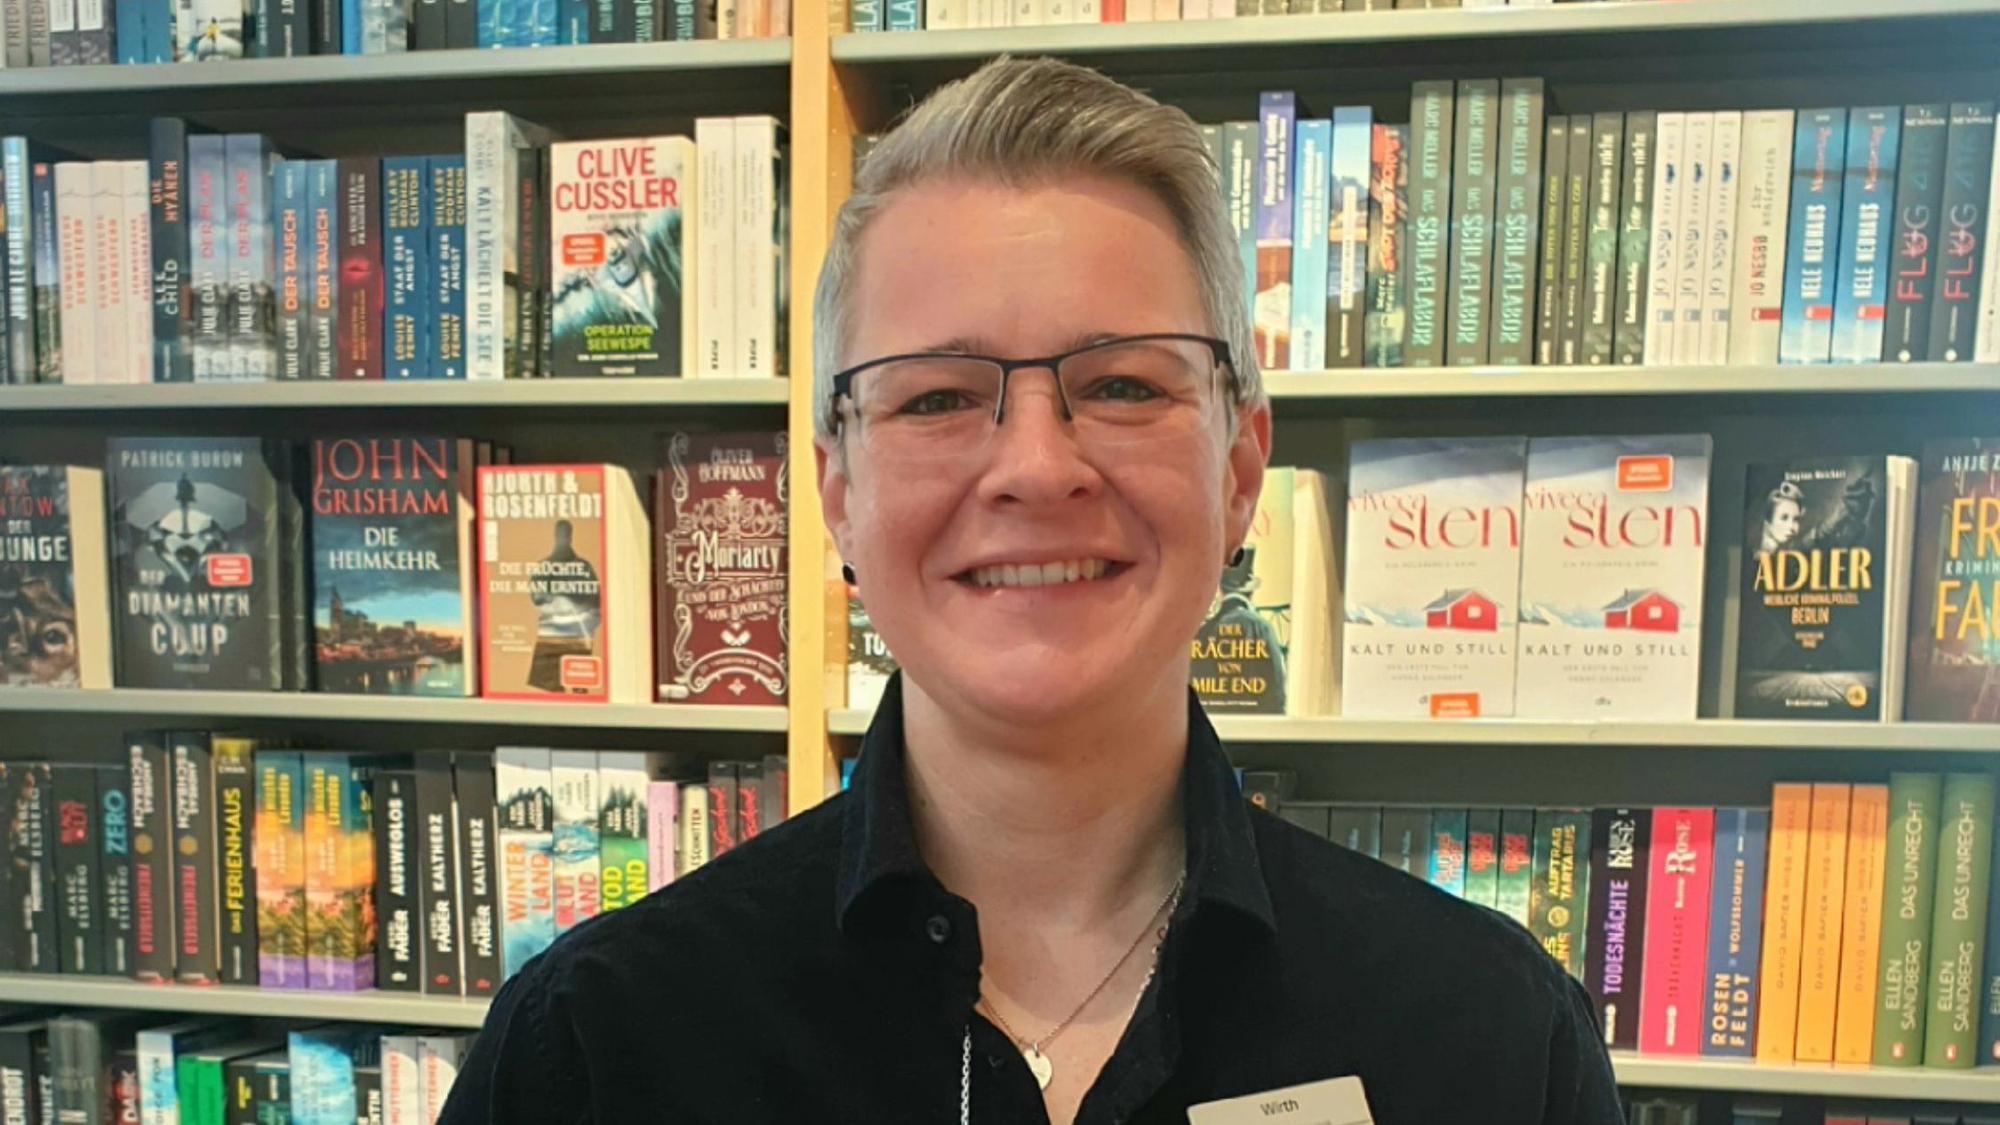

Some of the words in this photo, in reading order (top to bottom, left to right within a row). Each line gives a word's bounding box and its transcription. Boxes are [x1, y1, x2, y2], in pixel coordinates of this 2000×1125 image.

[577, 147, 655, 179] CLIVE
[1423, 129, 1439, 179] MELLER
[1467, 127, 1484, 176] MELLER
[1511, 126, 1527, 175] MELLER
[153, 179, 163, 203] DIE
[399, 168, 408, 227] RODHAM
[409, 168, 419, 227] CLINTON
[445, 167, 454, 225] RODHAM
[456, 167, 465, 224] CLINTON
[476, 187, 492, 223] KALT
[555, 177, 679, 212] CUSSLER
[1422, 190, 1436, 212] DAS
[1466, 188, 1481, 209] DAS
[1509, 187, 1525, 209] DAS
[285, 209, 297, 271] TAUSCH
[317, 208, 329, 270] TAUSCH
[394, 236, 404, 261] DER
[440, 234, 449, 260] DER
[1804, 204, 1827, 262] NEUHAUS
[1856, 203, 1880, 262] NEUHAUS
[1896, 205, 1930, 300] FLUG
[1944, 204, 1978, 300] FLUG
[405, 249, 414, 291] ANGST
[440, 265, 449, 302] STAAT
[450, 248, 460, 290] ANGST
[476, 230, 494, 296] LÄCHELT
[1412, 215, 1438, 345] SCHLAFLABOR
[1457, 213, 1484, 345] SCHLAFLABOR
[1499, 213, 1528, 345] SCHLAFLABOR
[1801, 268, 1822, 298] NELE
[1853, 267, 1875, 297] NELE
[155, 271, 166, 304] LEE
[166, 259, 178, 315] CHILD
[285, 276, 298, 311] DER
[317, 275, 329, 309] DER
[394, 267, 404, 304] STAAT
[1750, 282, 1765, 296] JO
[204, 306, 216, 335] JULIE
[239, 306, 252, 335] JULIE
[285, 319, 297, 349] CLARK
[318, 317, 329, 347] CLARK
[395, 314, 404, 360] LOUISE
[405, 316, 415, 358] PENNY
[441, 312, 450, 359] LOUISE
[451, 315, 460, 357] PENNY
[476, 303, 492, 328] DIE
[585, 325, 653, 338] OPERATION
[285, 352, 298, 378] JULIE
[318, 351, 329, 376] JULIE
[476, 334, 491, 362] SEE
[587, 337, 651, 351] SEEWESPE
[121, 450, 184, 468] PATRICK
[191, 451, 243, 468] BUROW
[313, 438, 448, 492] JOHN
[699, 464, 766, 483] HOFFMANN
[710, 447, 753, 464] OLIVER
[1942, 456, 1987, 472] ANTJE
[312, 488, 449, 516] GRISHAM
[484, 471, 556, 494] HJORTH
[563, 471, 578, 493] &
[485, 493, 602, 519] ROSENFELDT
[1385, 497, 1518, 549] sten
[1563, 494, 1703, 549] sten
[365, 527, 399, 547] DIE
[685, 530, 780, 583] Moriarty
[139, 570, 165, 585] DER
[329, 550, 441, 571] HEIMKEHR
[499, 562, 523, 576] DIE
[526, 560, 590, 578] FRÜCHTE,
[1754, 547, 1872, 592] ADLER
[128, 593, 250, 617] DIAMANTEN
[490, 580, 513, 593] DIE
[516, 580, 548, 593] MAN
[550, 580, 600, 593] ERNTET
[1218, 624, 1242, 636] DER
[1792, 608, 1829, 624] BERLIN
[151, 623, 228, 657] COUP
[1190, 637, 1270, 660] RÄCHER
[1351, 644, 1394, 655] KALT
[1406, 643, 1445, 654] UND
[1456, 643, 1507, 654] STILL
[1526, 644, 1572, 655] KALT
[1584, 643, 1623, 654] UND
[1636, 643, 1689, 655] STILL
[1191, 678, 1229, 694] MILE
[1232, 678, 1266, 694] END
[1218, 664, 1242, 674] VON
[131, 745, 145, 827] ESCHBACH
[176, 745, 189, 828] ESCHBACH
[103, 789, 128, 855] ZERO
[1904, 799, 1924, 882] UNRECHT
[1955, 800, 1976, 883] UNRECHT
[224, 787, 245, 909] FERIENHAUS
[389, 798, 406, 896] AUSWEGLOS
[429, 814, 446, 891] KALTHERZ
[470, 818, 487, 895] KALTHERZ
[1549, 827, 1562, 896] AUFTRAG
[1561, 825, 1576, 900] TARTARUS
[66, 874, 77, 918] MARC
[78, 864, 89, 928] ELSBERG
[108, 874, 118, 919] MARC
[119, 864, 130, 930] ELSBERG
[506, 841, 528, 922] WINTER
[531, 852, 551, 912] LAND
[602, 867, 623, 912] TOD
[1900, 885, 1918, 919] DAS
[1952, 886, 1971, 920] DAS
[437, 900, 452, 952] FABER
[1729, 859, 1745, 953] WOLFSSOMMER
[1779, 894, 1791, 940] SAFIER
[1817, 895, 1829, 941] SAFIER
[1857, 896, 1868, 941] SAFIER
[395, 910, 409, 961] FABER
[477, 905, 492, 956] FABER
[1602, 879, 1629, 994] TODESNÄCHTE
[1776, 945, 1787, 988] DAVID
[1813, 946, 1825, 990] DAVID
[1853, 948, 1866, 991] DAVID
[1885, 959, 1902, 1010] ELLEN
[1901, 940, 1922, 1031] SANDBERG
[1937, 961, 1955, 1012] ELLEN
[1954, 941, 1975, 1032] SANDBERG
[1711, 973, 1731, 1046] ROSEN
[1731, 974, 1750, 1047] FELDT
[1260, 1099, 1300, 1116] Wirth
